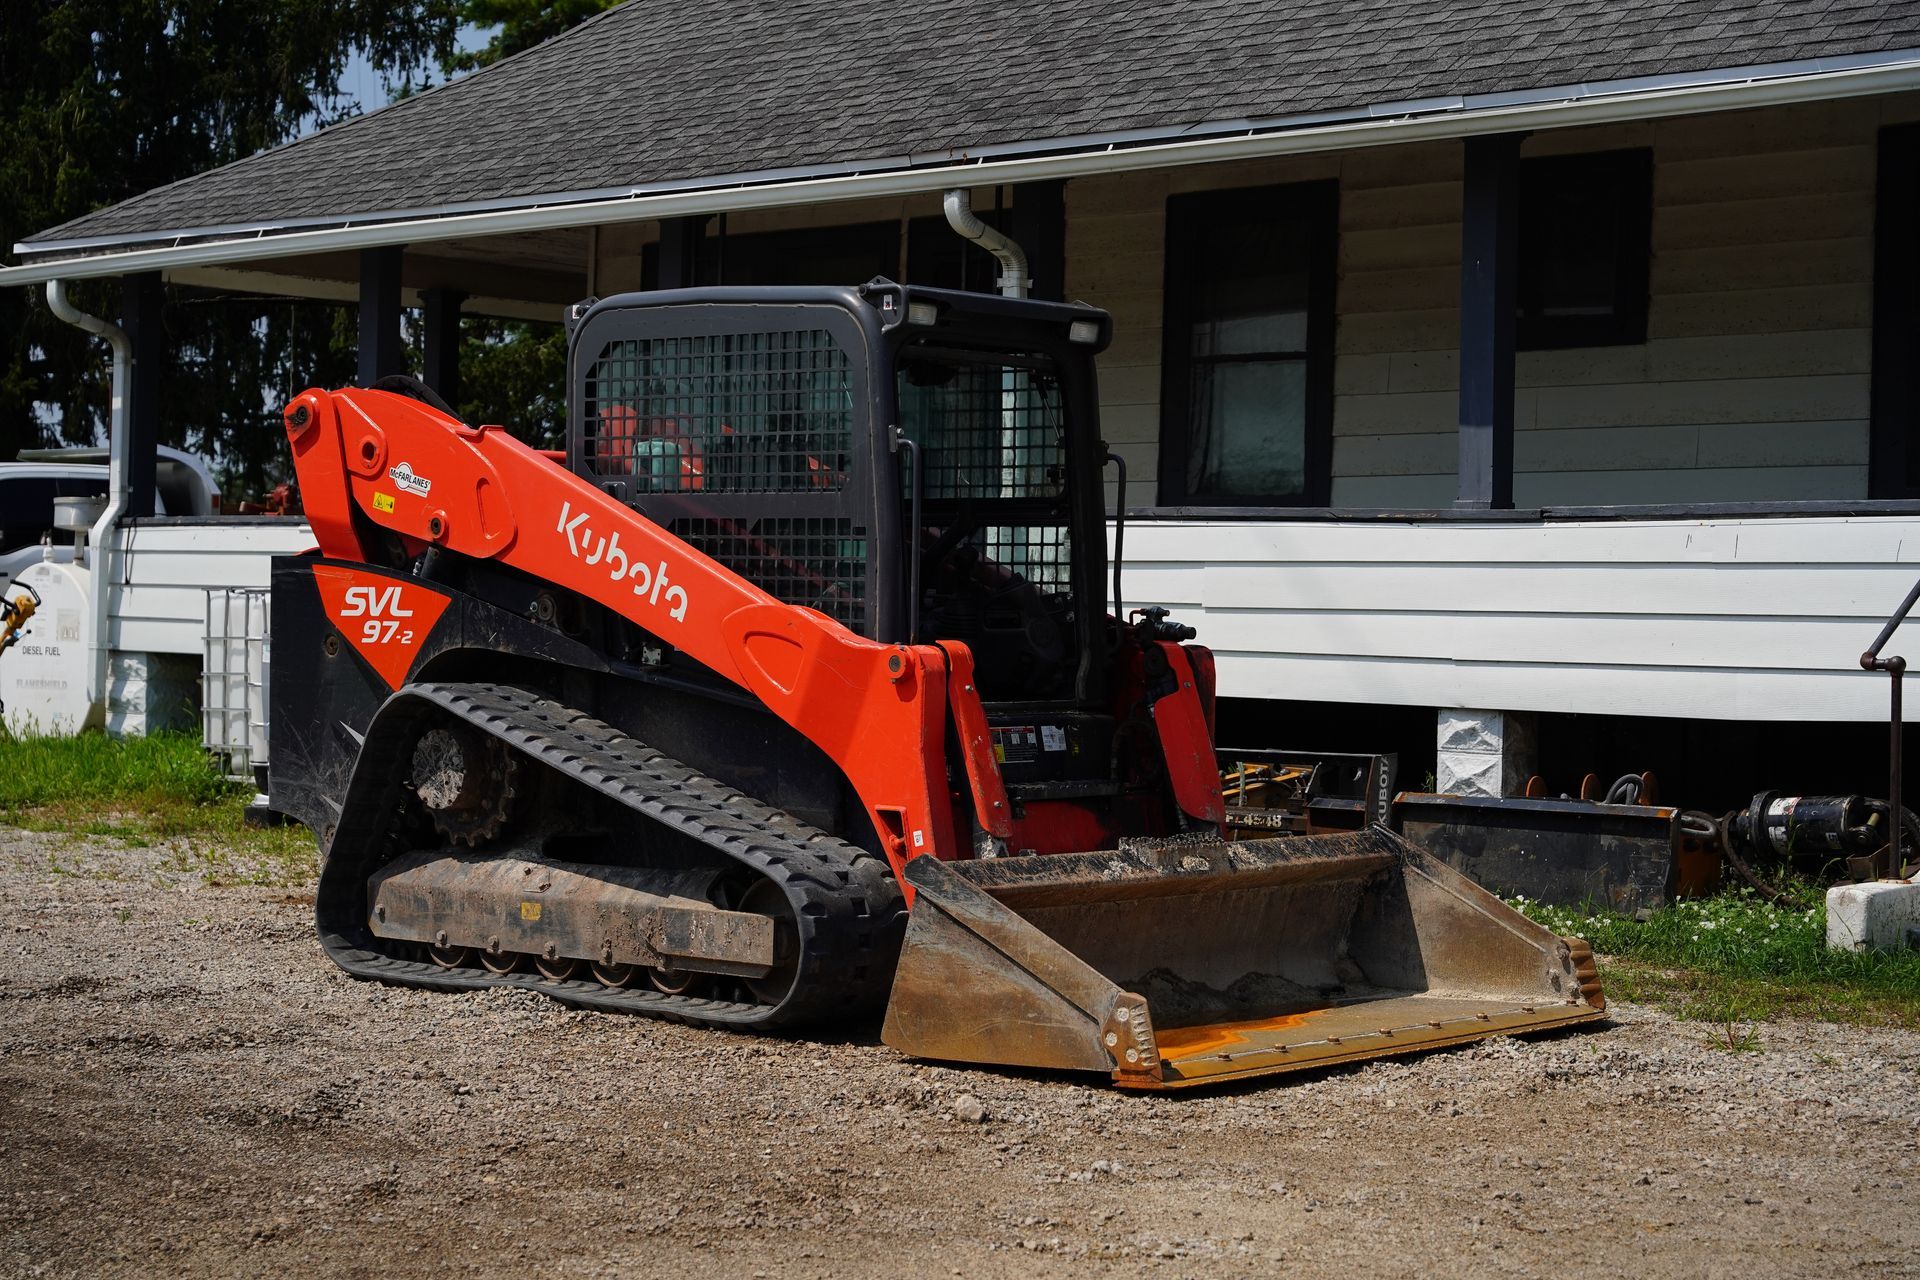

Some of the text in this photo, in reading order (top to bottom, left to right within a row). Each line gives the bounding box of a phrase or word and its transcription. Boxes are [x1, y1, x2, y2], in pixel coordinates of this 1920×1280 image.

[556, 501, 688, 623] Kubota
[340, 587, 413, 617] SVL
[361, 620, 413, 644] 97-2
[22, 646, 61, 656] DIESEL FUEL
